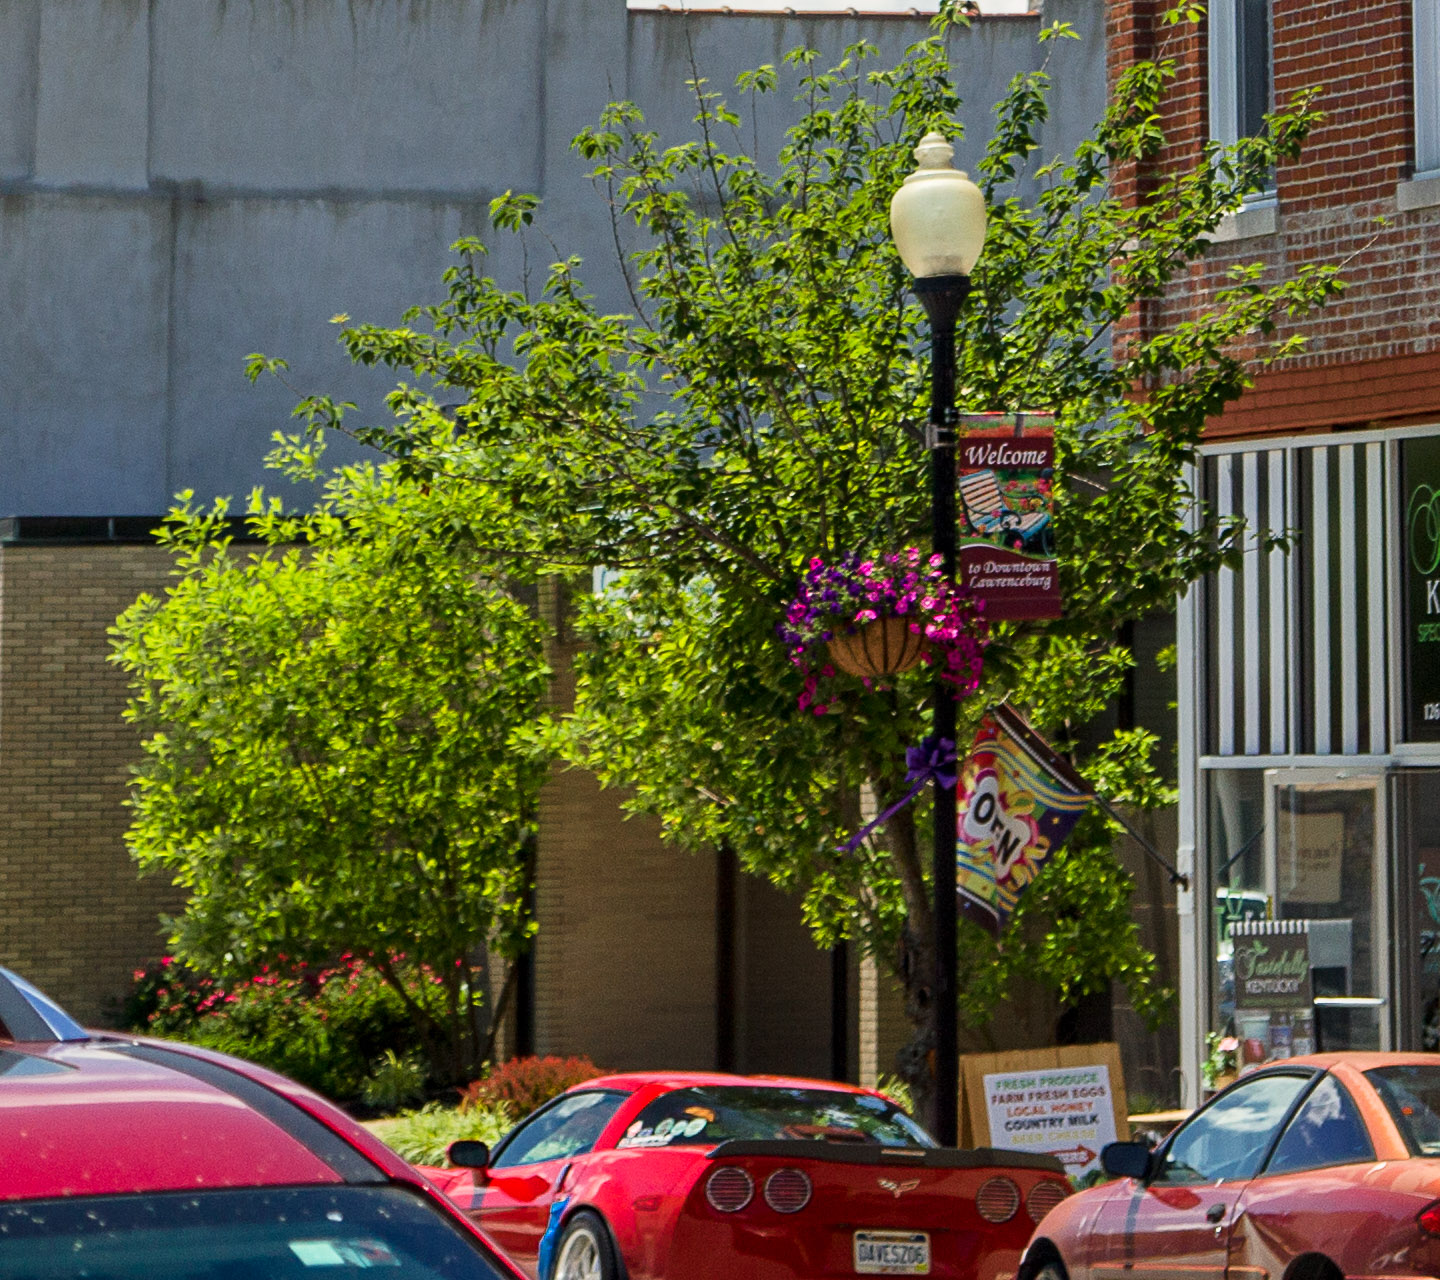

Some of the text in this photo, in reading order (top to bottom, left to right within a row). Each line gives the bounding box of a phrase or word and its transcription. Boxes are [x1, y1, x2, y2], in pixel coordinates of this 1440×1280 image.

[965, 442, 1047, 465] Welcome
[968, 557, 1051, 575] to Downtown
[969, 571, 1053, 590] Lawrenceburg
[1423, 702, 1440, 721] 126
[996, 1072, 1099, 1090] FRESH PRODUCE
[991, 1085, 1107, 1106] FARM FRESH EGGS
[1007, 1101, 1094, 1118] LOCAL HONEY
[1004, 1114, 1101, 1132] COUNTRY MILK
